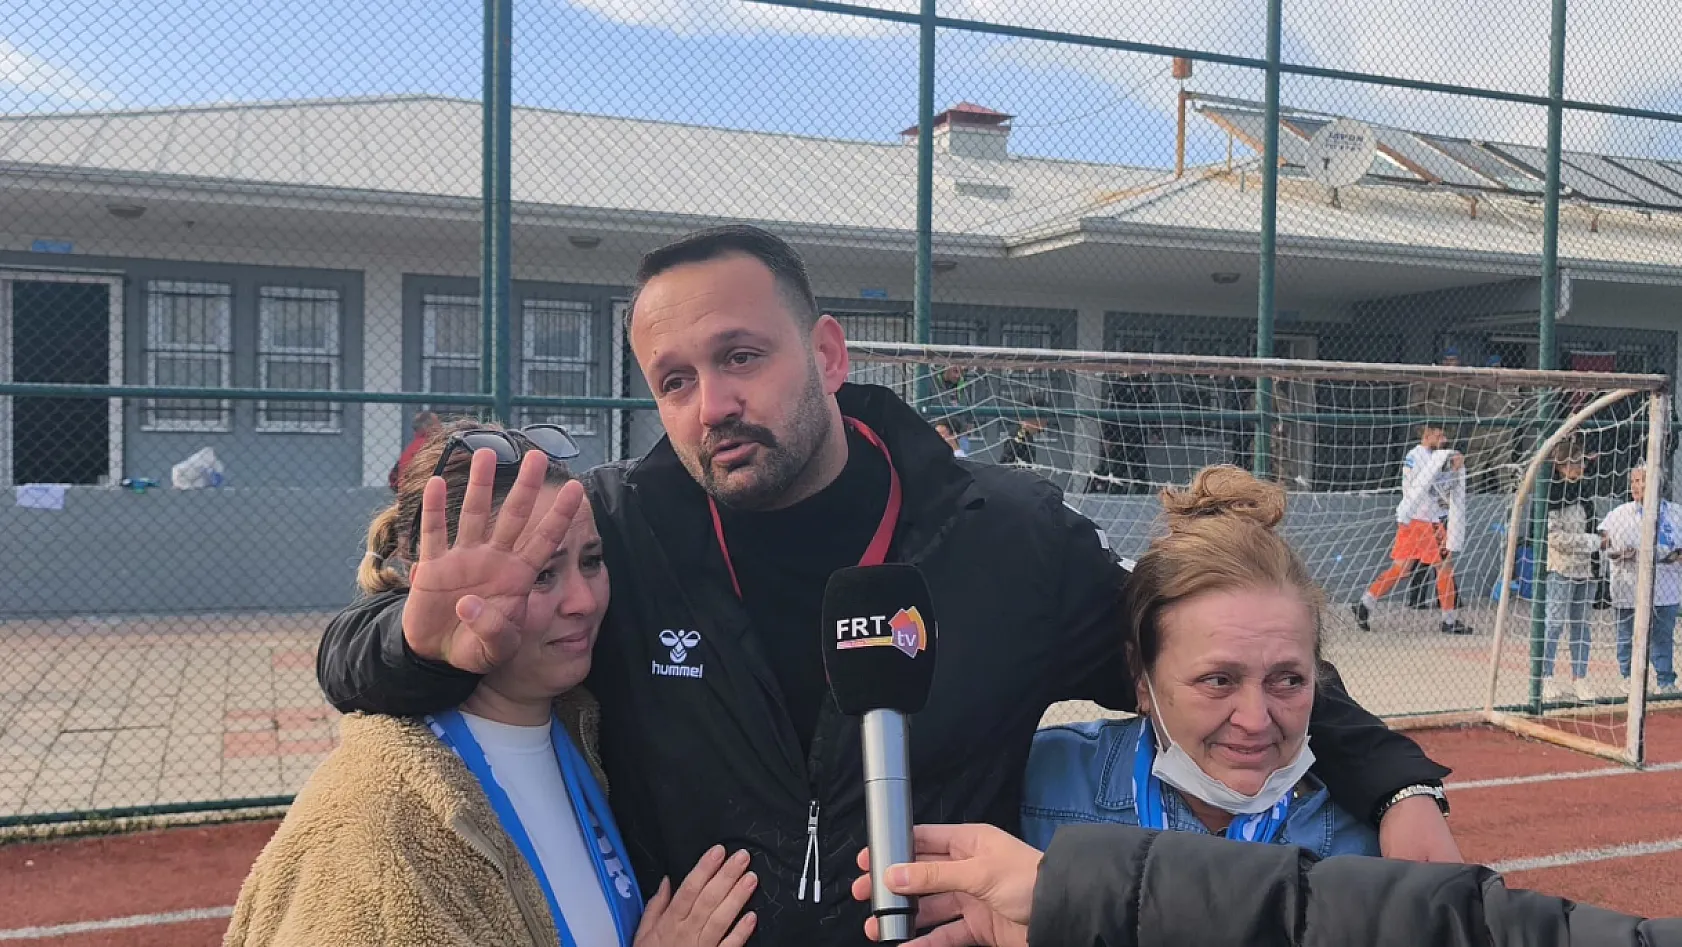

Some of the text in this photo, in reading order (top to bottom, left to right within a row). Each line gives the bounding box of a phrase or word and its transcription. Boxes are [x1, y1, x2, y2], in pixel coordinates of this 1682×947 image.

[836, 615, 886, 640] FRT
[897, 630, 917, 647] tv
[651, 659, 703, 679] hummel
